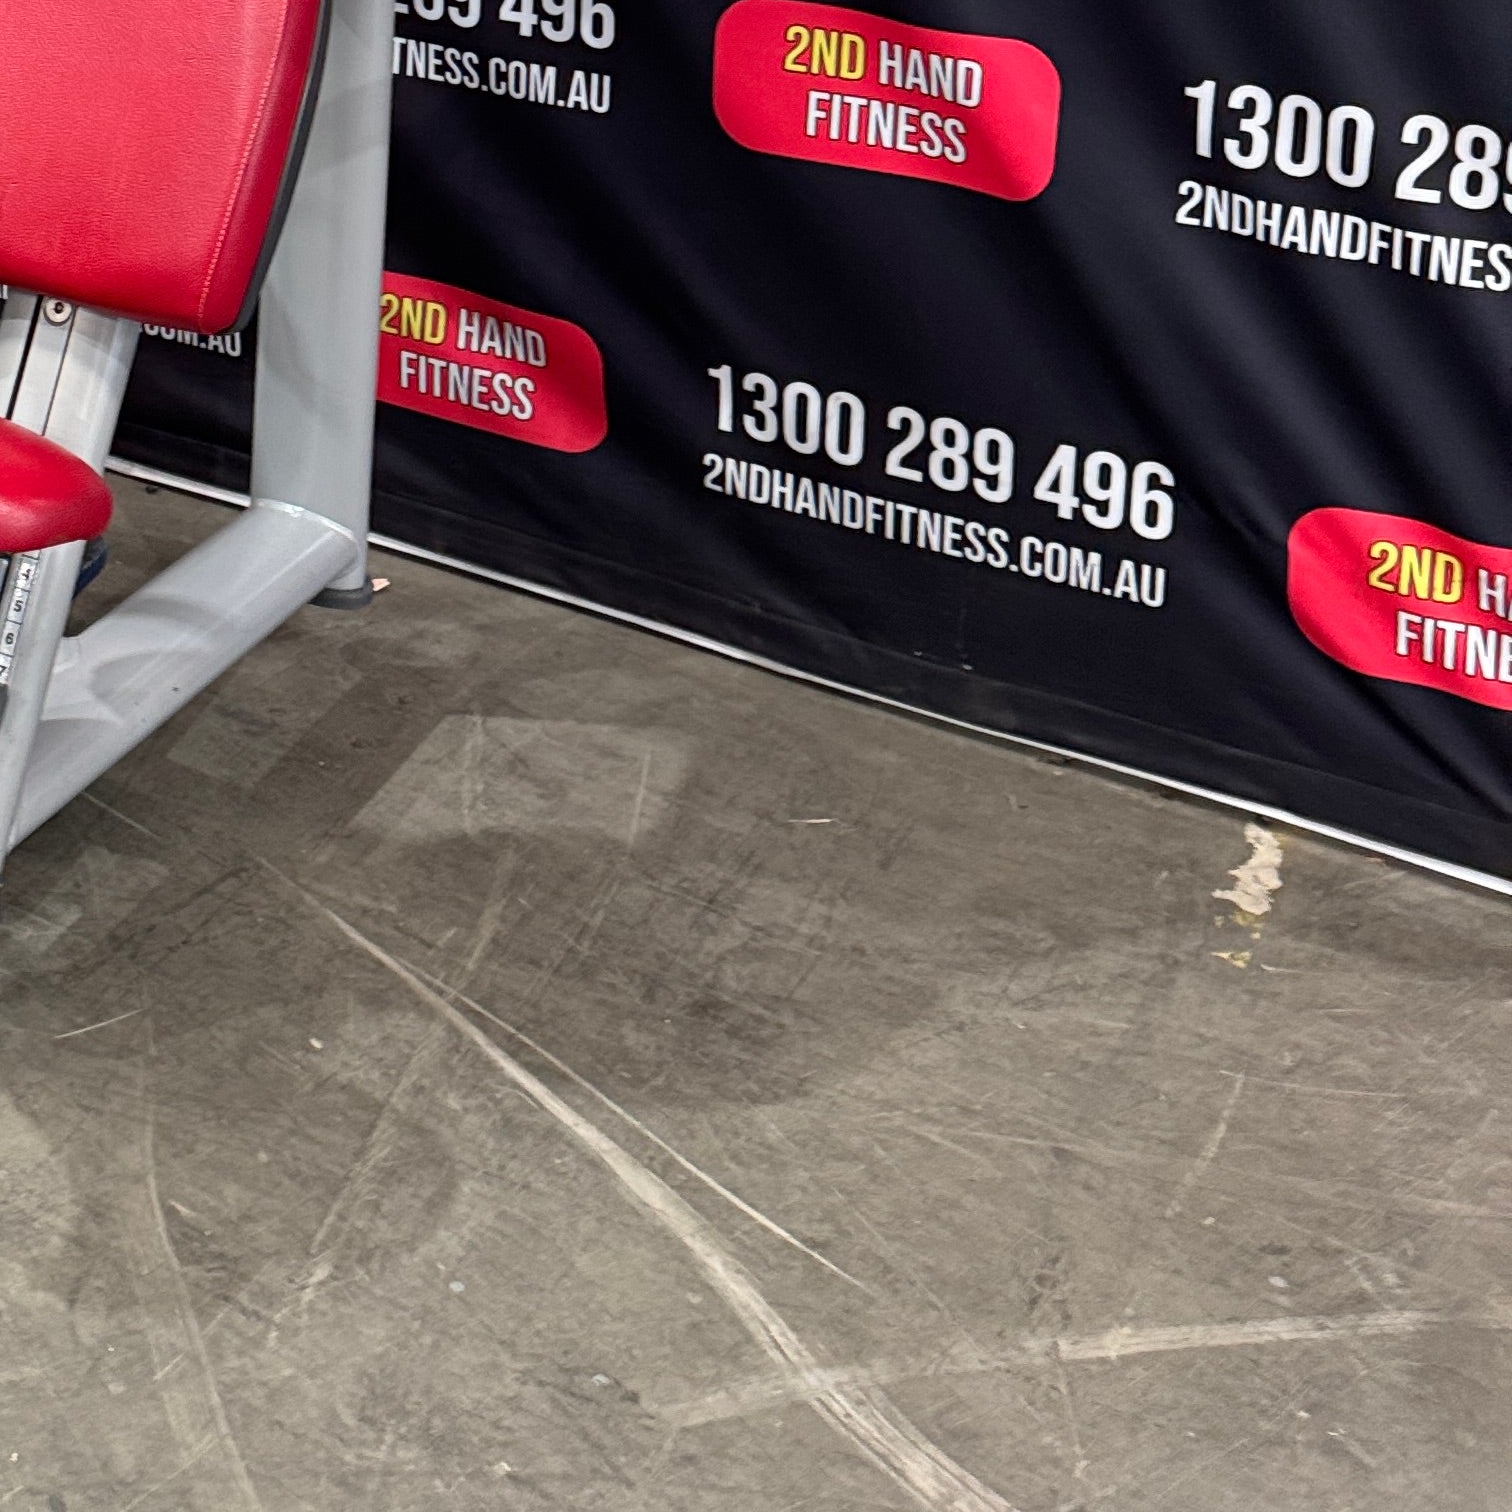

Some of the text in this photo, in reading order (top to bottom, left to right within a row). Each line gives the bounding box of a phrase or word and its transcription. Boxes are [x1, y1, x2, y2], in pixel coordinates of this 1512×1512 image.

[392, 37, 611, 113] TNESS.COM.AU
[785, 27, 982, 106] 2ND HAND
[807, 91, 965, 162] FITNESS
[1185, 80, 1512, 215] 1300 28
[1175, 180, 1512, 292] 2NDHANDFITNES
[382, 294, 544, 365] 2ND HAND
[401, 351, 533, 419] FITNESS
[709, 365, 1174, 539] 1300 289 496
[704, 452, 1166, 607] 2NDHANDFITNESS.COM.AU
[1370, 542, 1461, 602] 2ND
[5, 632, 14, 644] 6
[1398, 612, 1512, 682] FITNE
